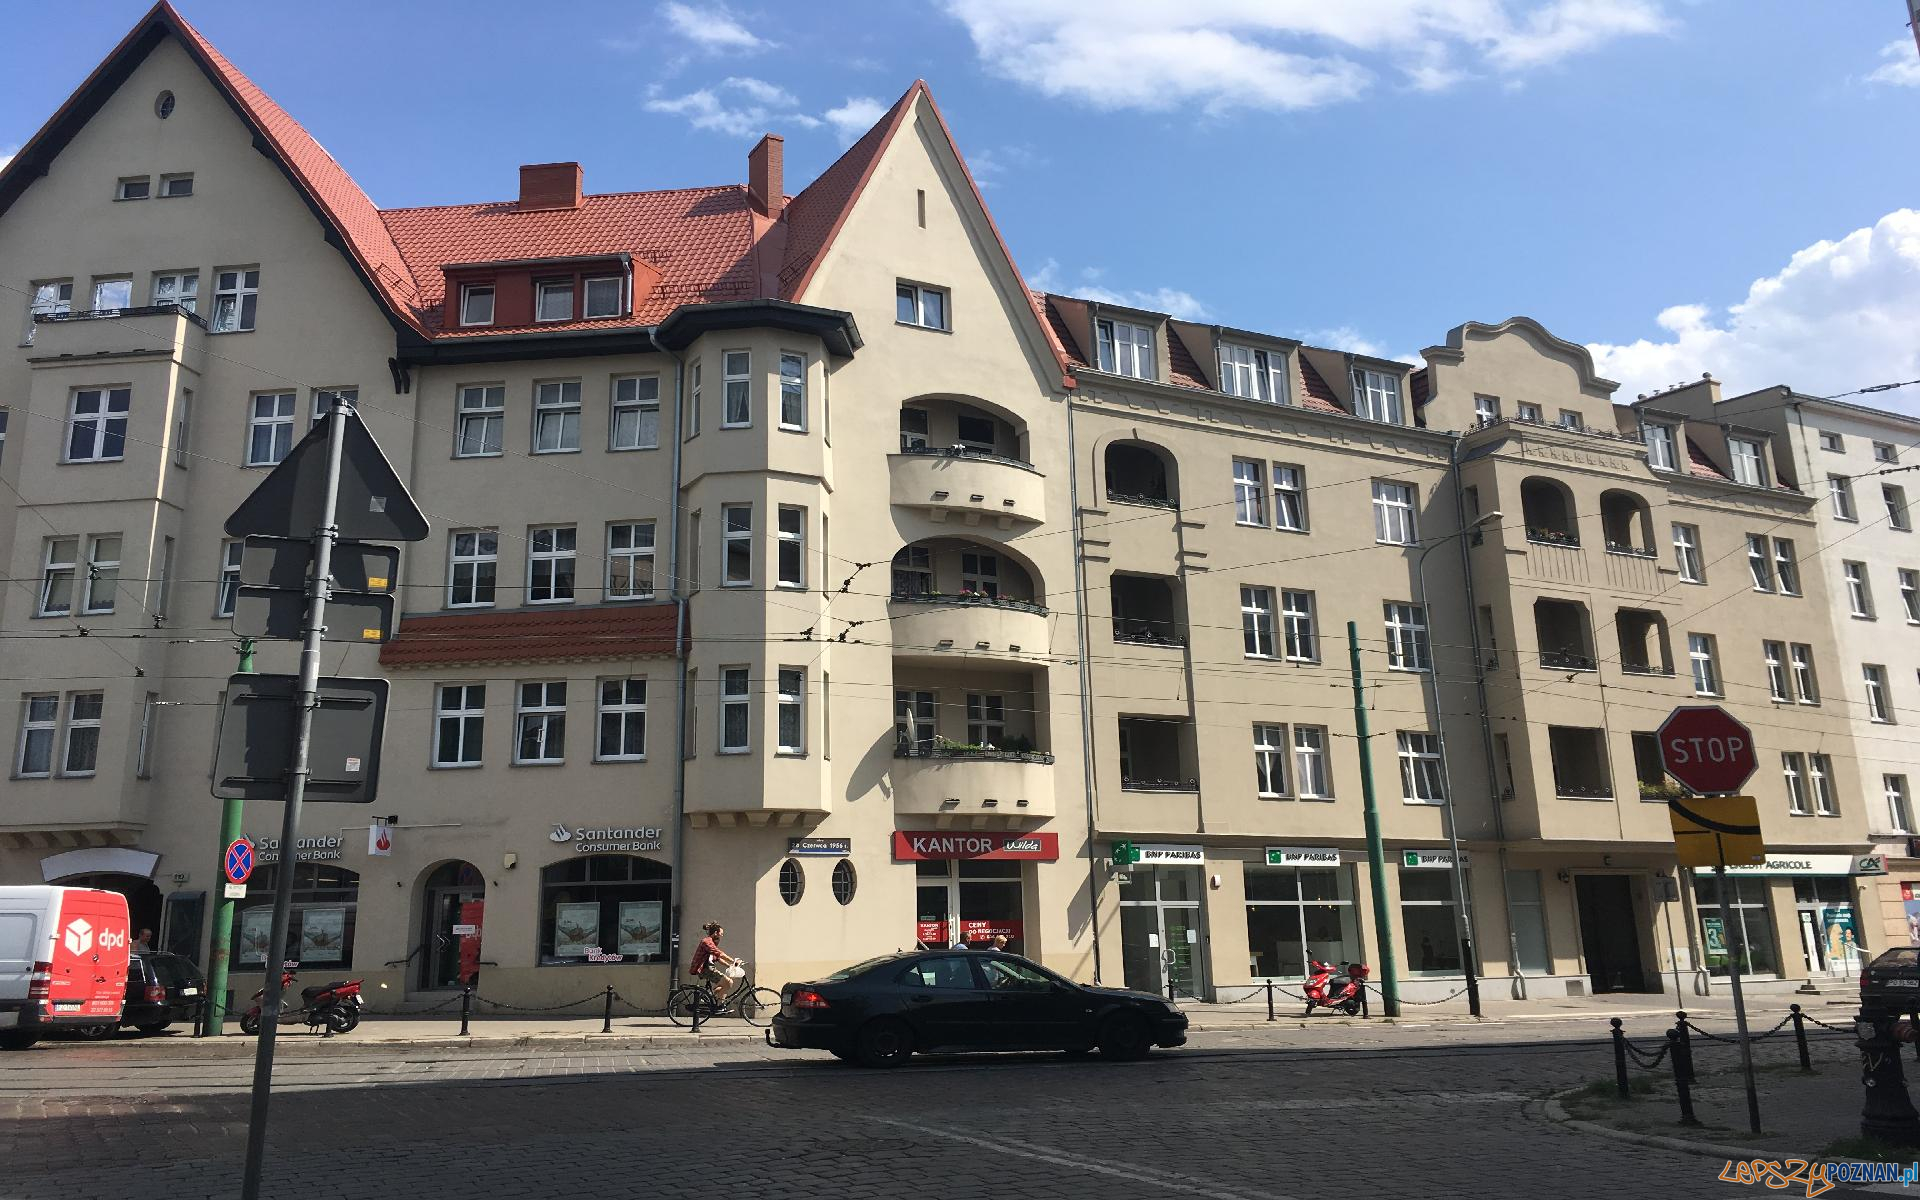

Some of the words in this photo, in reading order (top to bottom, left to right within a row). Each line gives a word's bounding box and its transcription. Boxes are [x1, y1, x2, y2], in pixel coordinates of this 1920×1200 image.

[1671, 736, 1744, 763] STOP
[575, 826, 662, 840] Santander
[260, 835, 343, 849] Saander
[575, 843, 631, 852] Consumer
[632, 841, 661, 851] Bank
[913, 837, 993, 853] KANTOR
[259, 851, 311, 860] Coner
[313, 849, 341, 859] Bank
[1145, 851, 1163, 859] BNP
[1164, 851, 1201, 859] PARIBAS
[1286, 853, 1303, 861] BNP
[1303, 853, 1338, 861] PARIBAS
[1422, 855, 1437, 863] BNP
[1765, 860, 1813, 870] AGRICOLE
[99, 927, 125, 951] dpd
[583, 946, 603, 955] Bank
